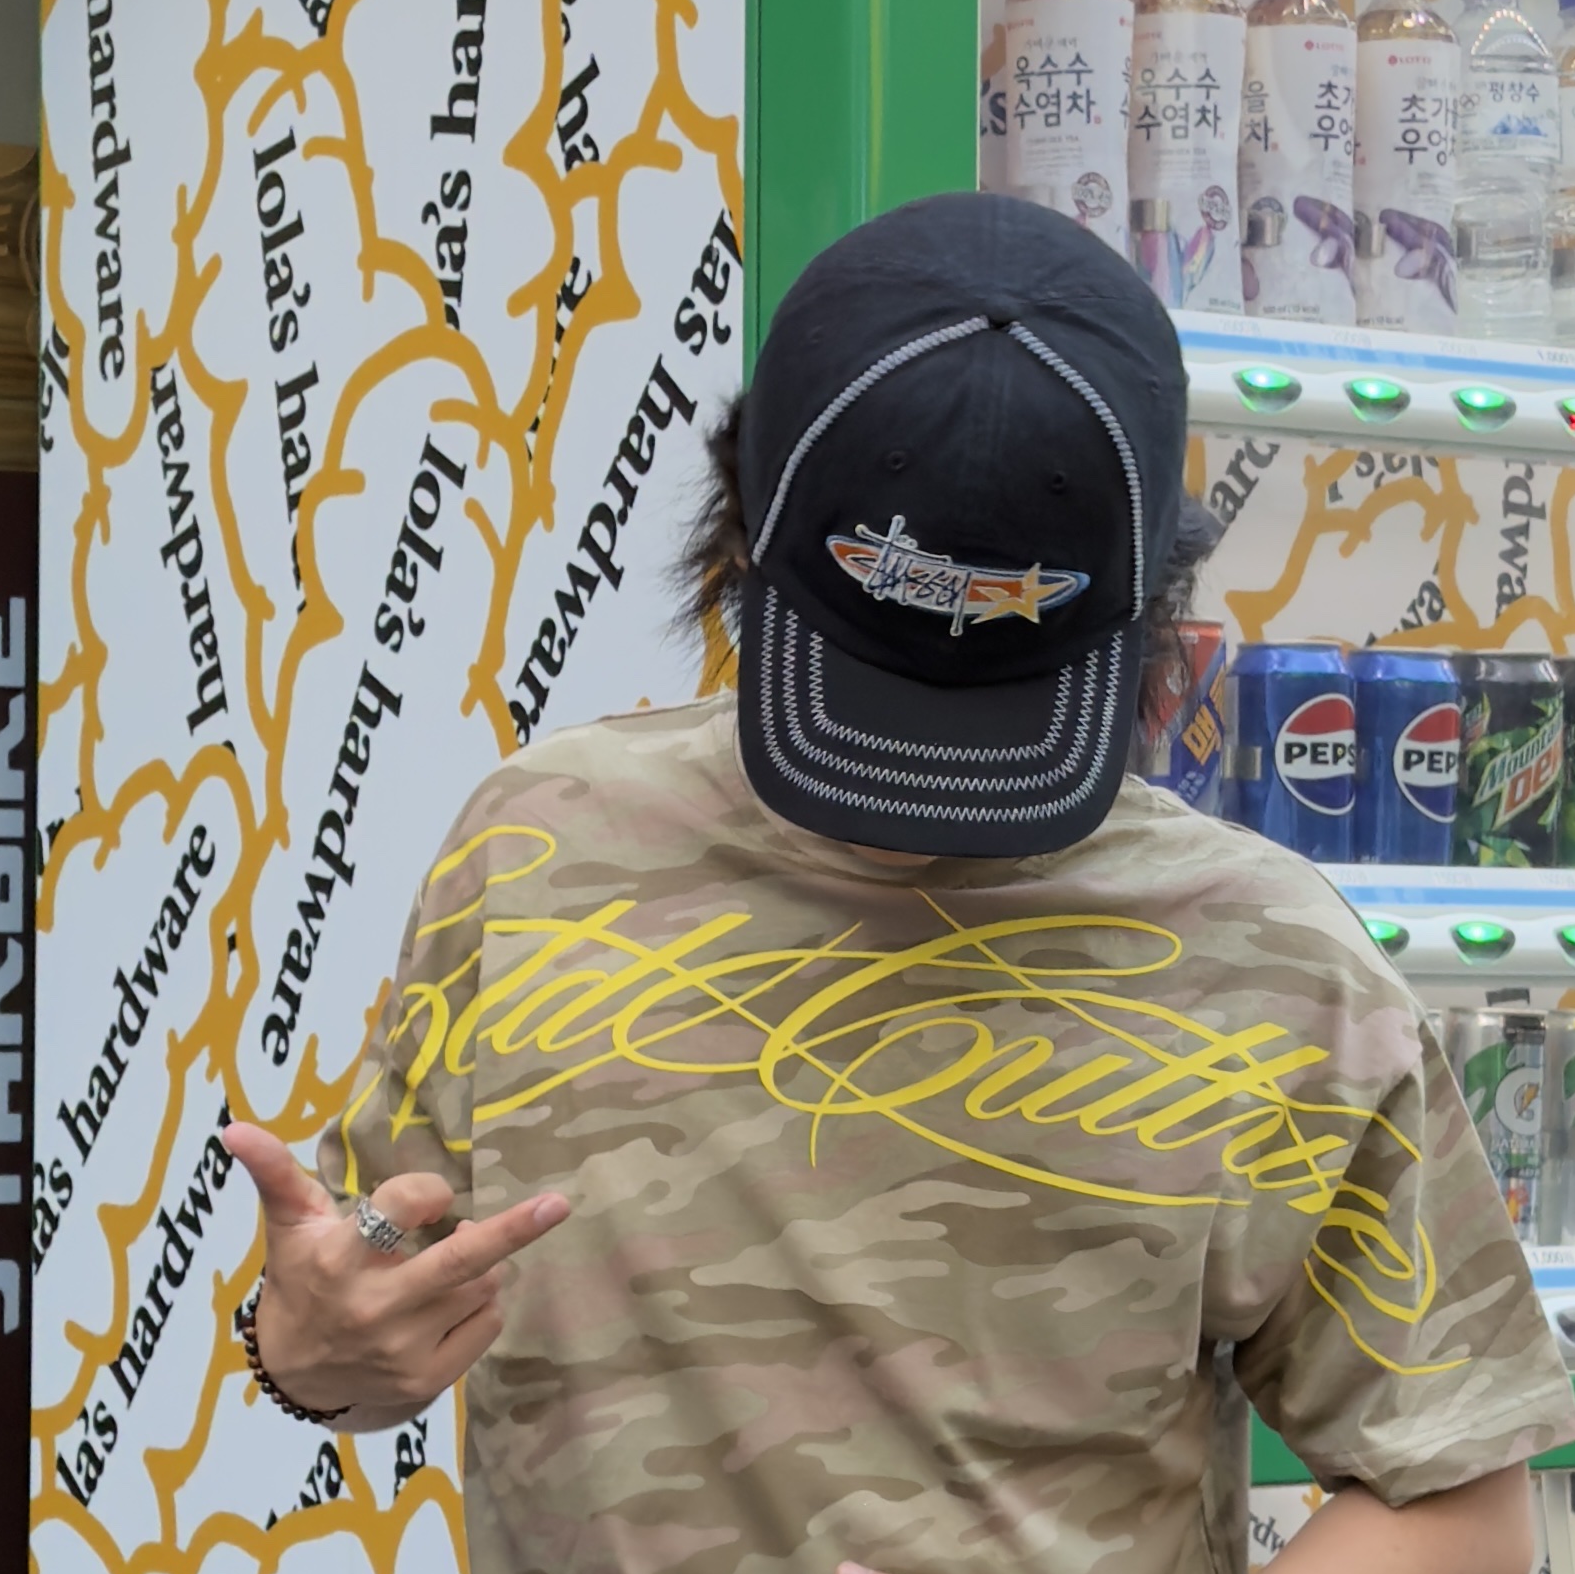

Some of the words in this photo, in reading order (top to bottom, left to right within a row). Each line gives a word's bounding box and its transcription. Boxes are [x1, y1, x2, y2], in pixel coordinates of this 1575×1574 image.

[1012, 51, 1095, 91] 옥수수
[1135, 66, 1222, 104] 옥수수
[1487, 80, 1542, 104] 평창수
[1013, 88, 1097, 130] 수염차
[1134, 101, 1222, 142] 수염차
[249, 124, 314, 353] lola's
[371, 431, 467, 656] lola's
[260, 659, 404, 1069] hardware
[56, 823, 218, 1162] hardware
